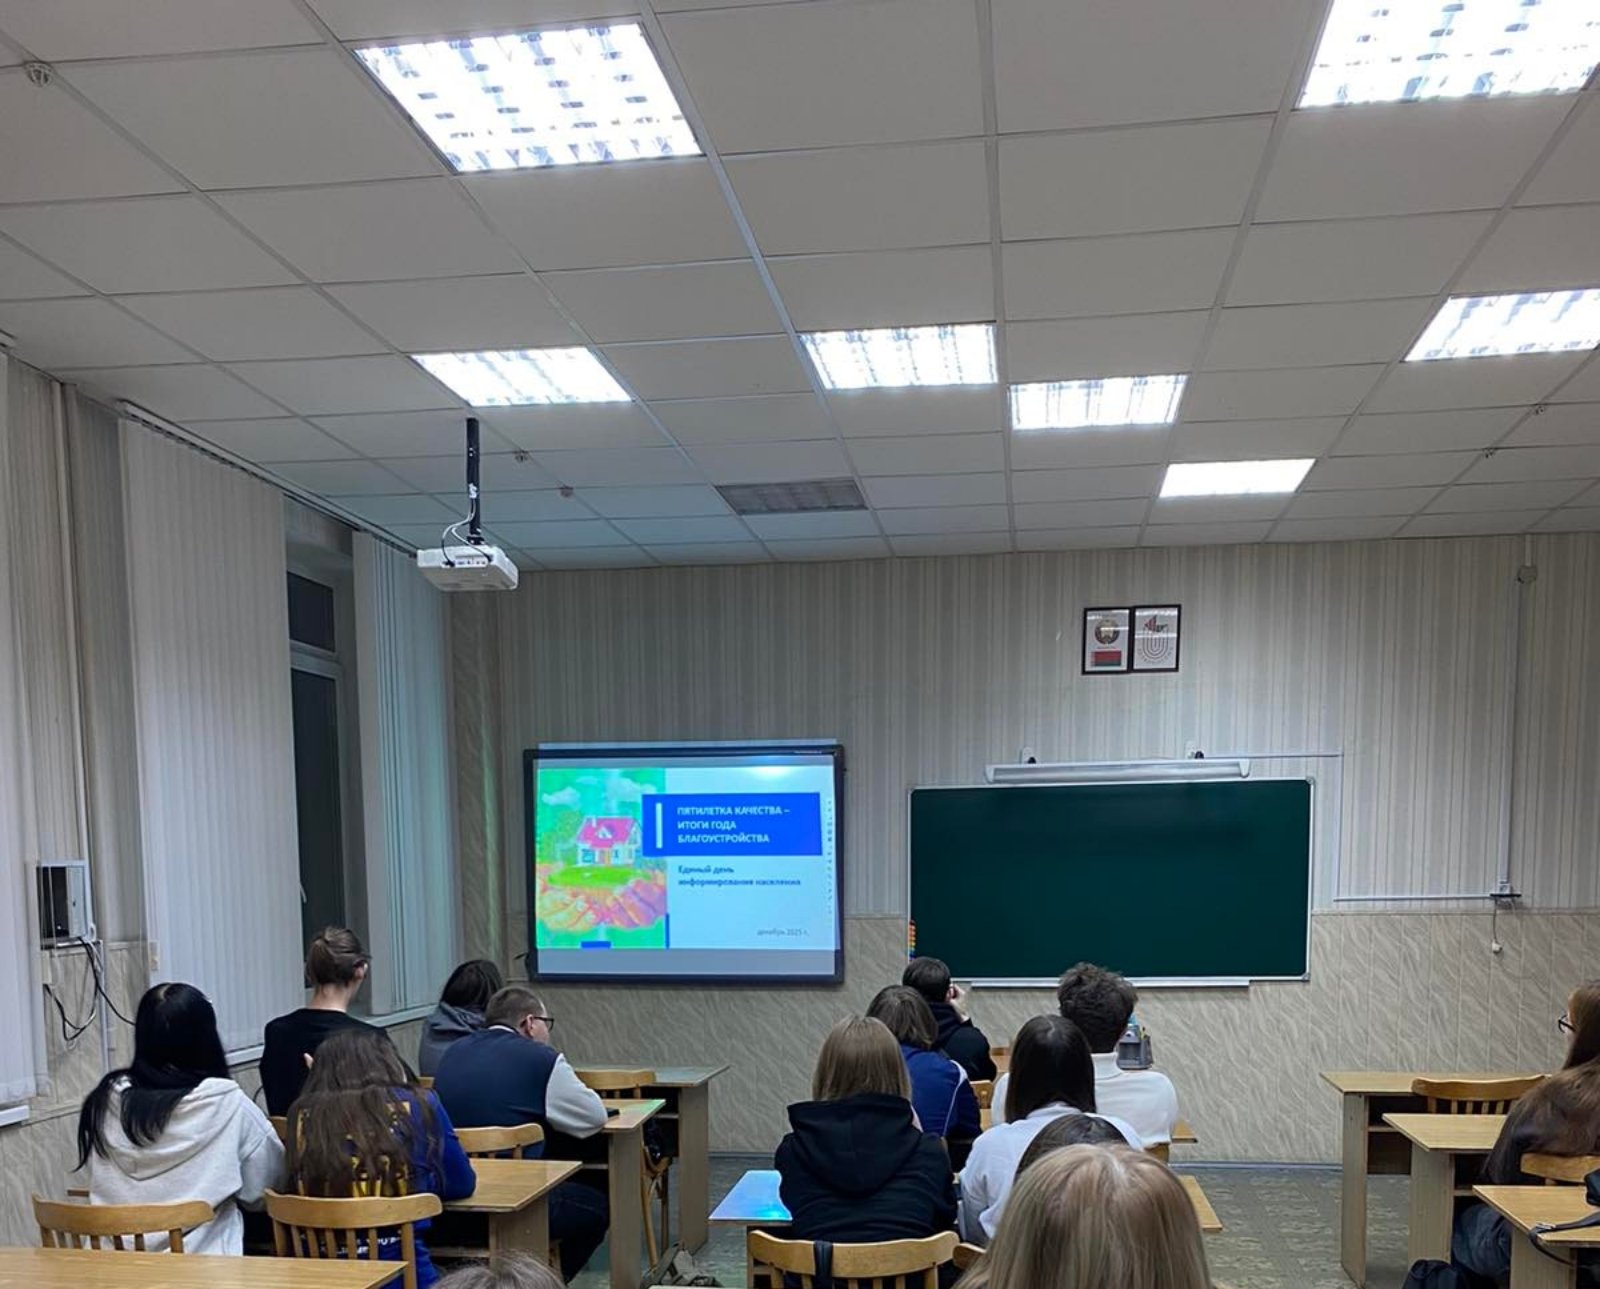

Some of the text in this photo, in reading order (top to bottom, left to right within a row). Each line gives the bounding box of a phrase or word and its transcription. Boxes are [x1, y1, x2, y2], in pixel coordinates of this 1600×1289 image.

[677, 806, 733, 816] ПЯТИЛЕТКА
[734, 805, 782, 815] КАЧЕСТВА
[677, 820, 737, 830] ИТОГИ ГОДА
[677, 832, 770, 843] БЛАГОУСТРОЙСТВА
[678, 865, 735, 874] Единый день
[678, 878, 754, 887] информирования
